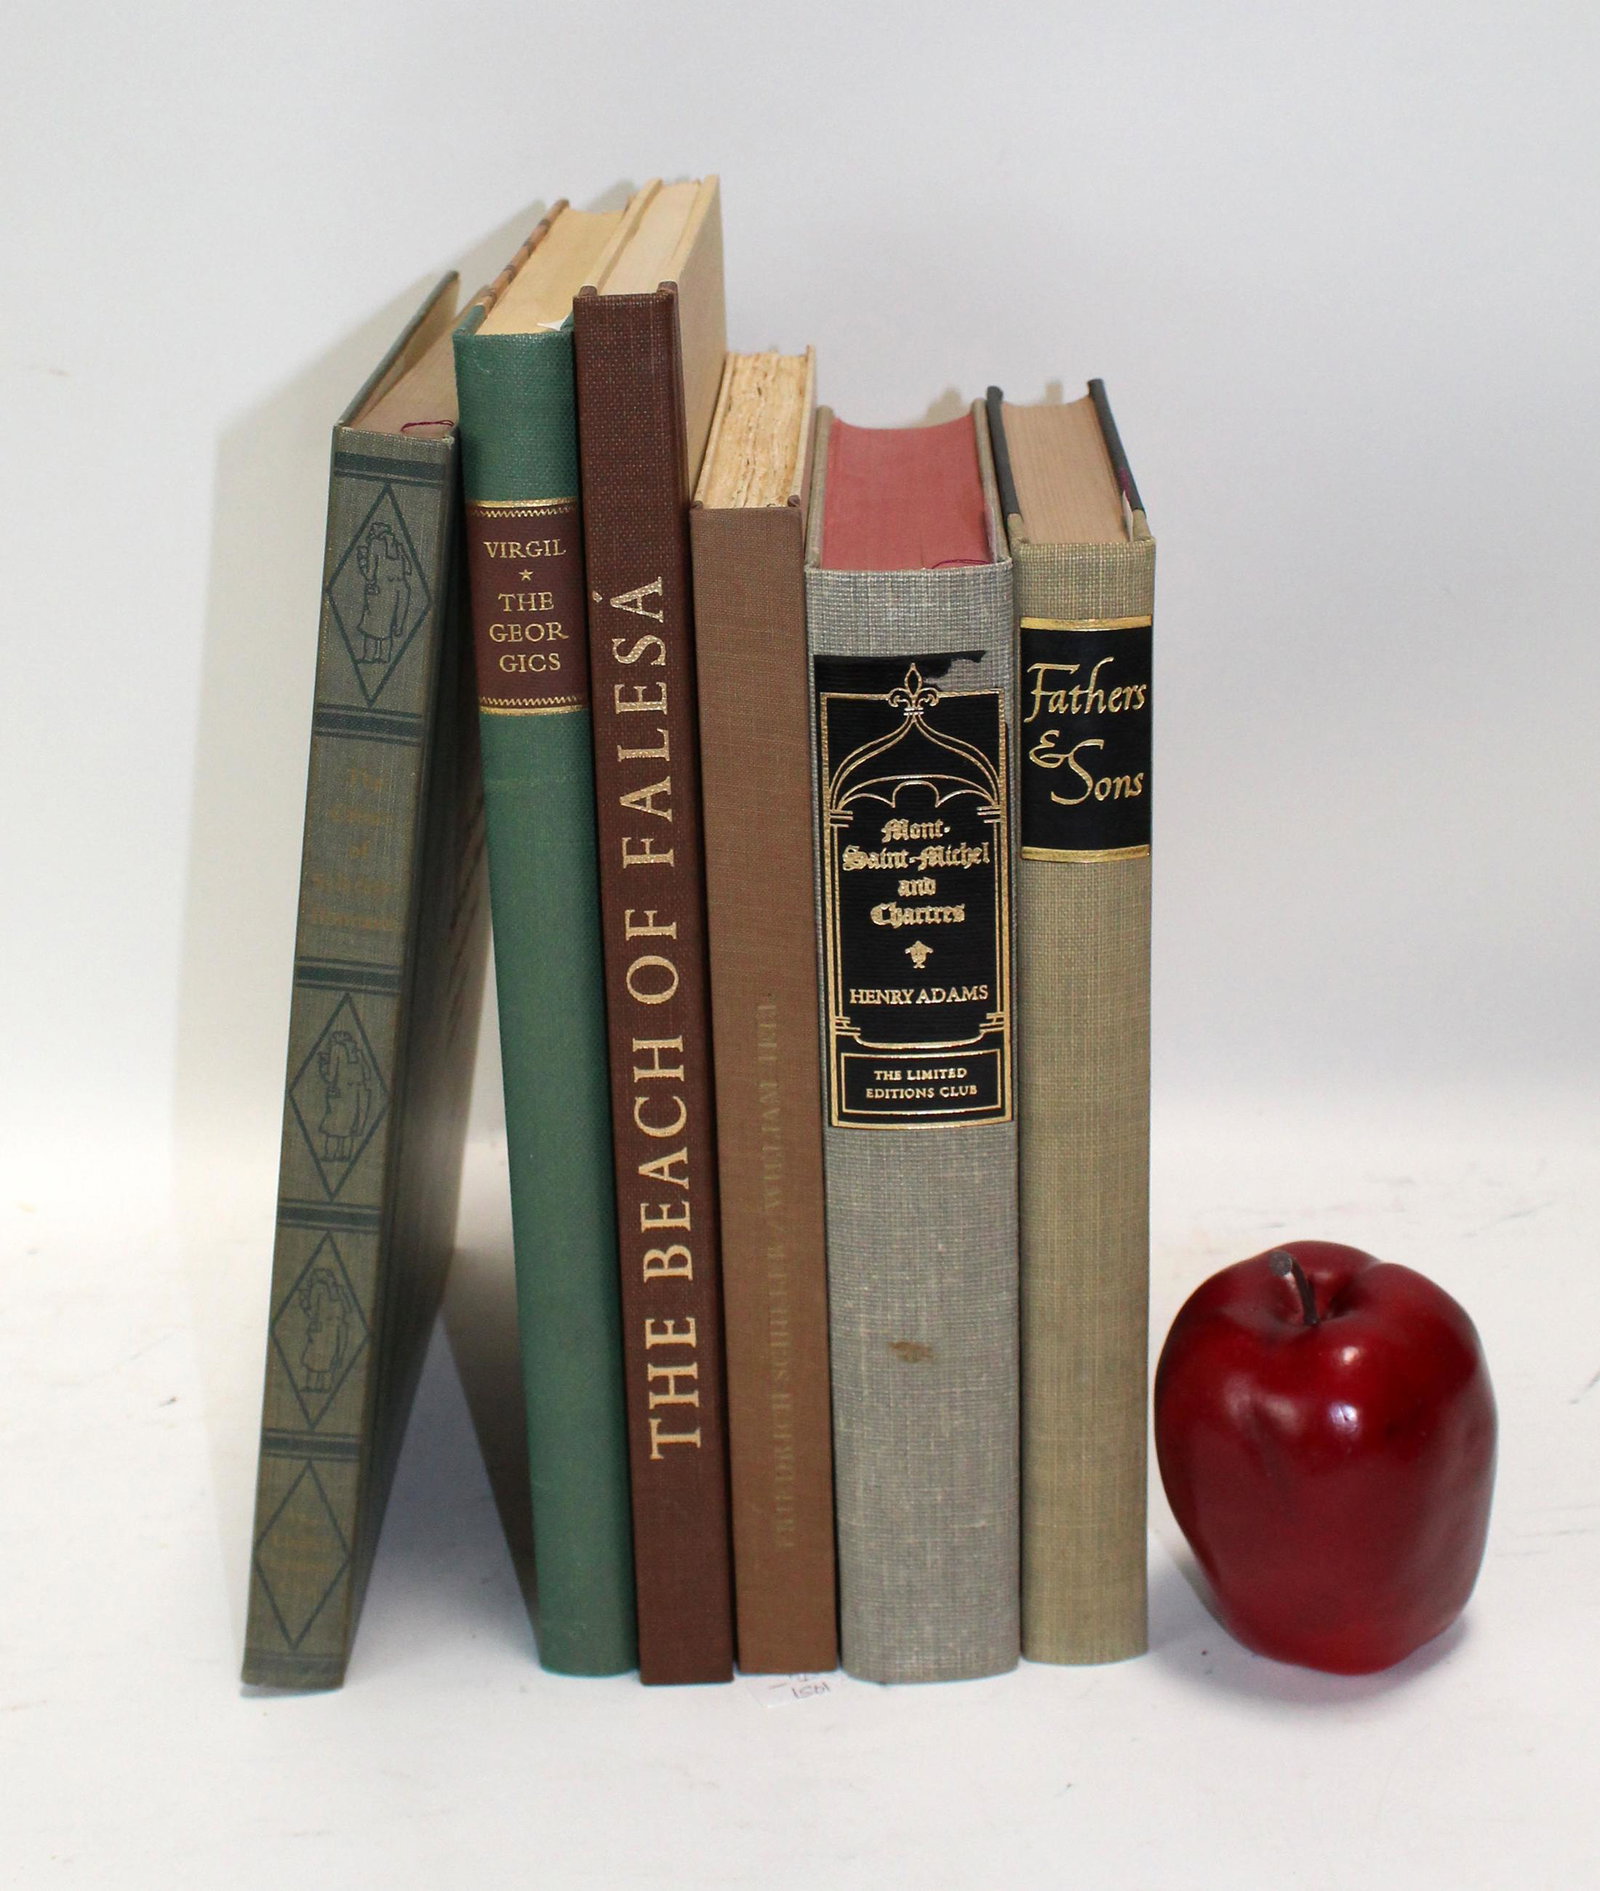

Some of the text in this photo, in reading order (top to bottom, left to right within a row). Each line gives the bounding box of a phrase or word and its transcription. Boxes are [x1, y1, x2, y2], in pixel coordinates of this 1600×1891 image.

[483, 538, 567, 559] VIRGIL
[498, 591, 555, 613] THE
[489, 621, 570, 644] GEOR
[499, 652, 562, 673] GICS
[1023, 656, 1147, 723] Fathers
[1028, 729, 1144, 806] & Sons
[898, 876, 937, 897] and
[869, 902, 967, 929] Chartres
[624, 908, 680, 1005] OF
[849, 984, 989, 1005] HENRY ADAMS
[874, 1067, 968, 1081] THE LIMITED
[865, 1085, 979, 1099] EDITIONS CLUB
[632, 1034, 694, 1284] BEACH
[646, 1316, 701, 1460] THE
